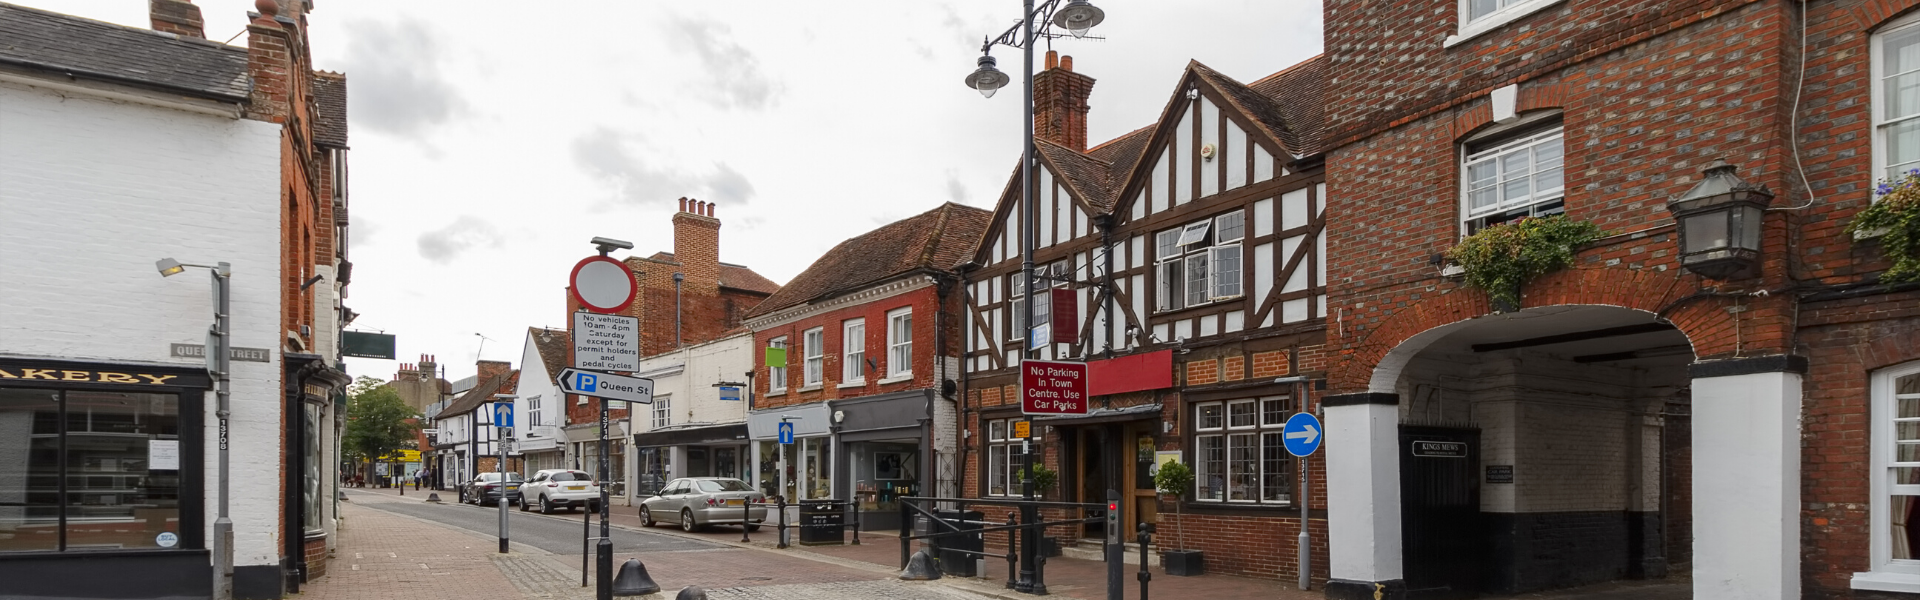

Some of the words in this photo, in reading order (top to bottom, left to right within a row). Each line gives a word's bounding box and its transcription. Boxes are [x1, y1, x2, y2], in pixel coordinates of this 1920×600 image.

[589, 330, 625, 339] Saturday
[177, 346, 206, 356] QUEE
[229, 349, 265, 359] TREET
[607, 347, 636, 355] holders
[1031, 366, 1044, 376] No
[1047, 367, 1079, 379] Parking
[600, 381, 633, 393] Queen
[637, 386, 649, 395] St
[1038, 377, 1047, 387] In
[1050, 378, 1073, 388] Town
[1028, 388, 1061, 399] Centre.
[1063, 389, 1080, 399] Use
[1034, 399, 1050, 409] Car
[1053, 400, 1077, 410] Parks
[1422, 442, 1440, 450] KINGS
[1441, 443, 1459, 451] MEWS
